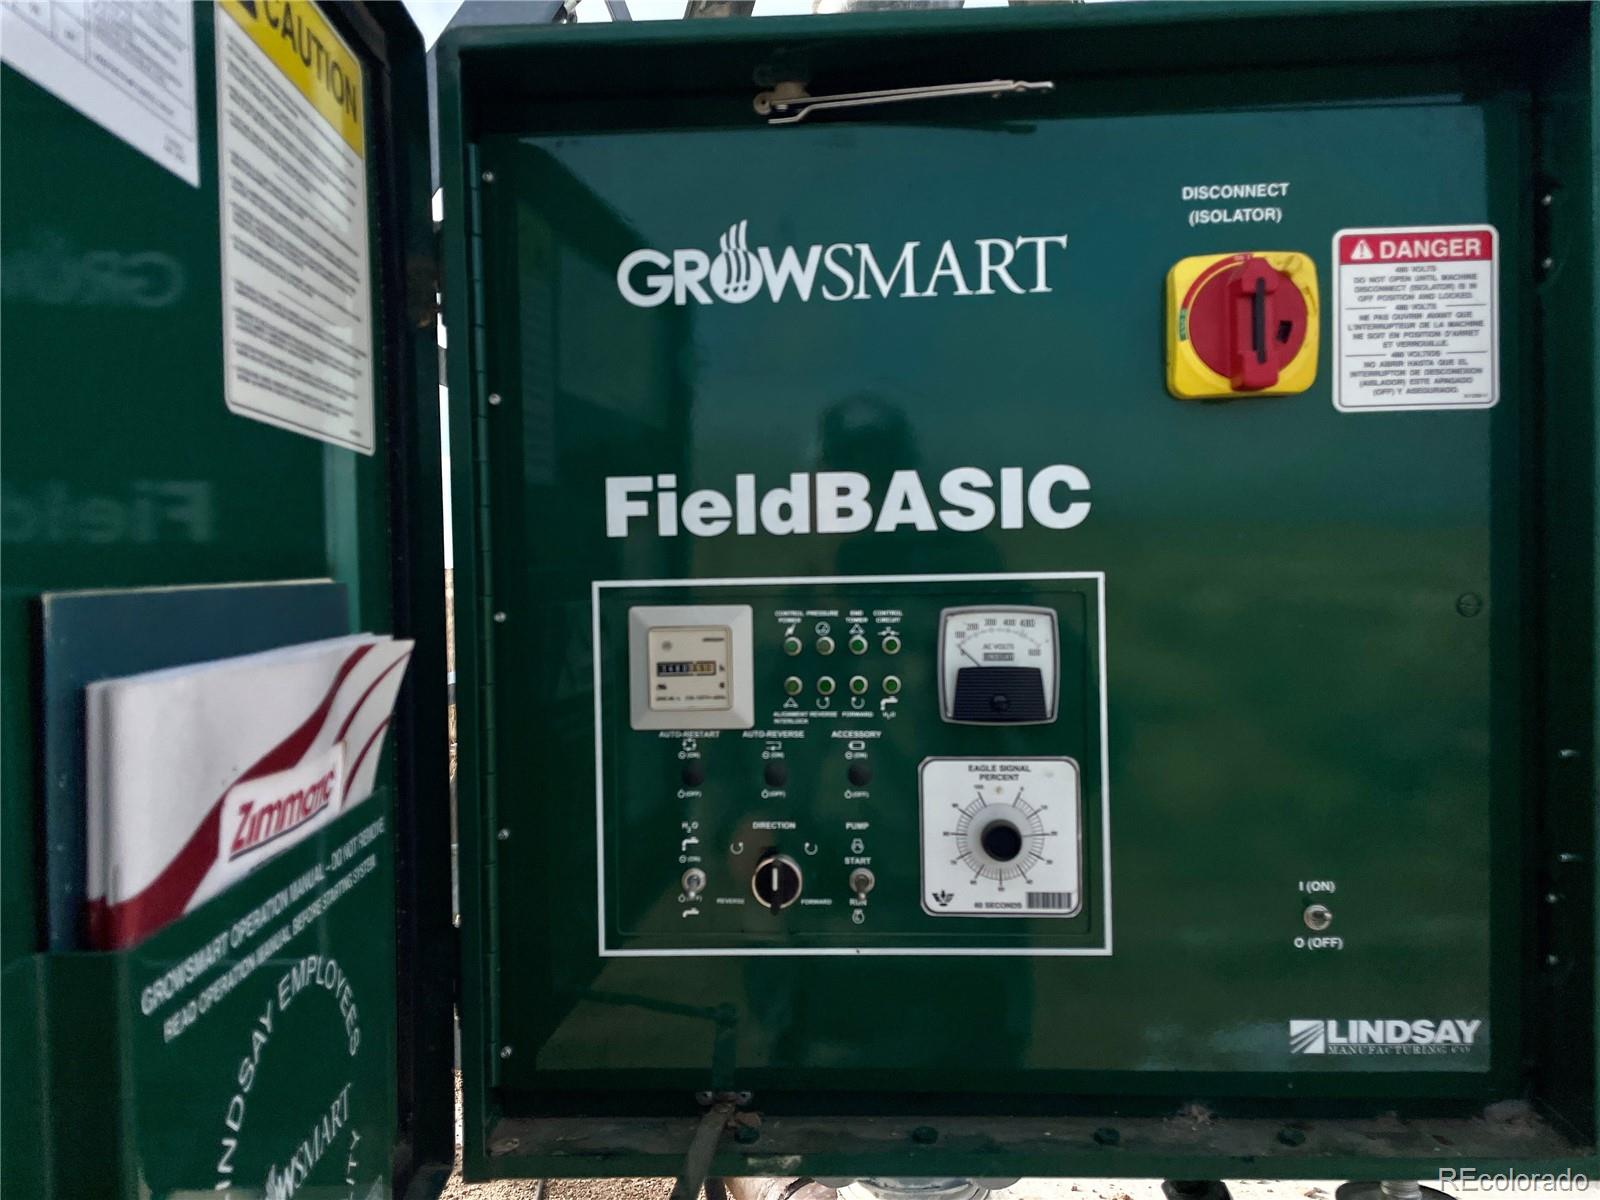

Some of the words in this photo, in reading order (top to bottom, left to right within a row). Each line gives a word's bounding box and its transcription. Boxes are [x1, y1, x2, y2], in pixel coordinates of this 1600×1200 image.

[264, 0, 357, 123] CAUTION
[1181, 182, 1290, 200] DISCONNECT
[1188, 207, 1282, 226] (ISOLATOR)
[1379, 238, 1482, 259] DANGER
[616, 219, 1068, 308] GROWSMART
[605, 464, 1092, 537] FieldBASIC
[658, 730, 720, 739] AUTO-RESTART
[742, 730, 805, 739] AUTO-REVERSE
[831, 730, 882, 739] ACCESSORY
[968, 764, 996, 772] EAGLE
[999, 764, 1031, 772] SIGNAL
[230, 769, 334, 853] Zimmatic
[752, 821, 796, 830] DIRECTION
[845, 821, 870, 830] PUMP
[844, 857, 872, 865] START
[1306, 881, 1336, 893] (ON)
[141, 932, 229, 1016] GROWSMART
[230, 891, 288, 948] OPERATION
[288, 864, 325, 902] MANUAL
[1308, 937, 1344, 950] (OFF)
[163, 1000, 197, 1043] READ
[199, 953, 256, 1014] OPERATION
[277, 955, 361, 1057] EMPLOYEES
[1326, 1020, 1482, 1044] LINDSAY
[1327, 1044, 1447, 1056] MANUFACTURING
